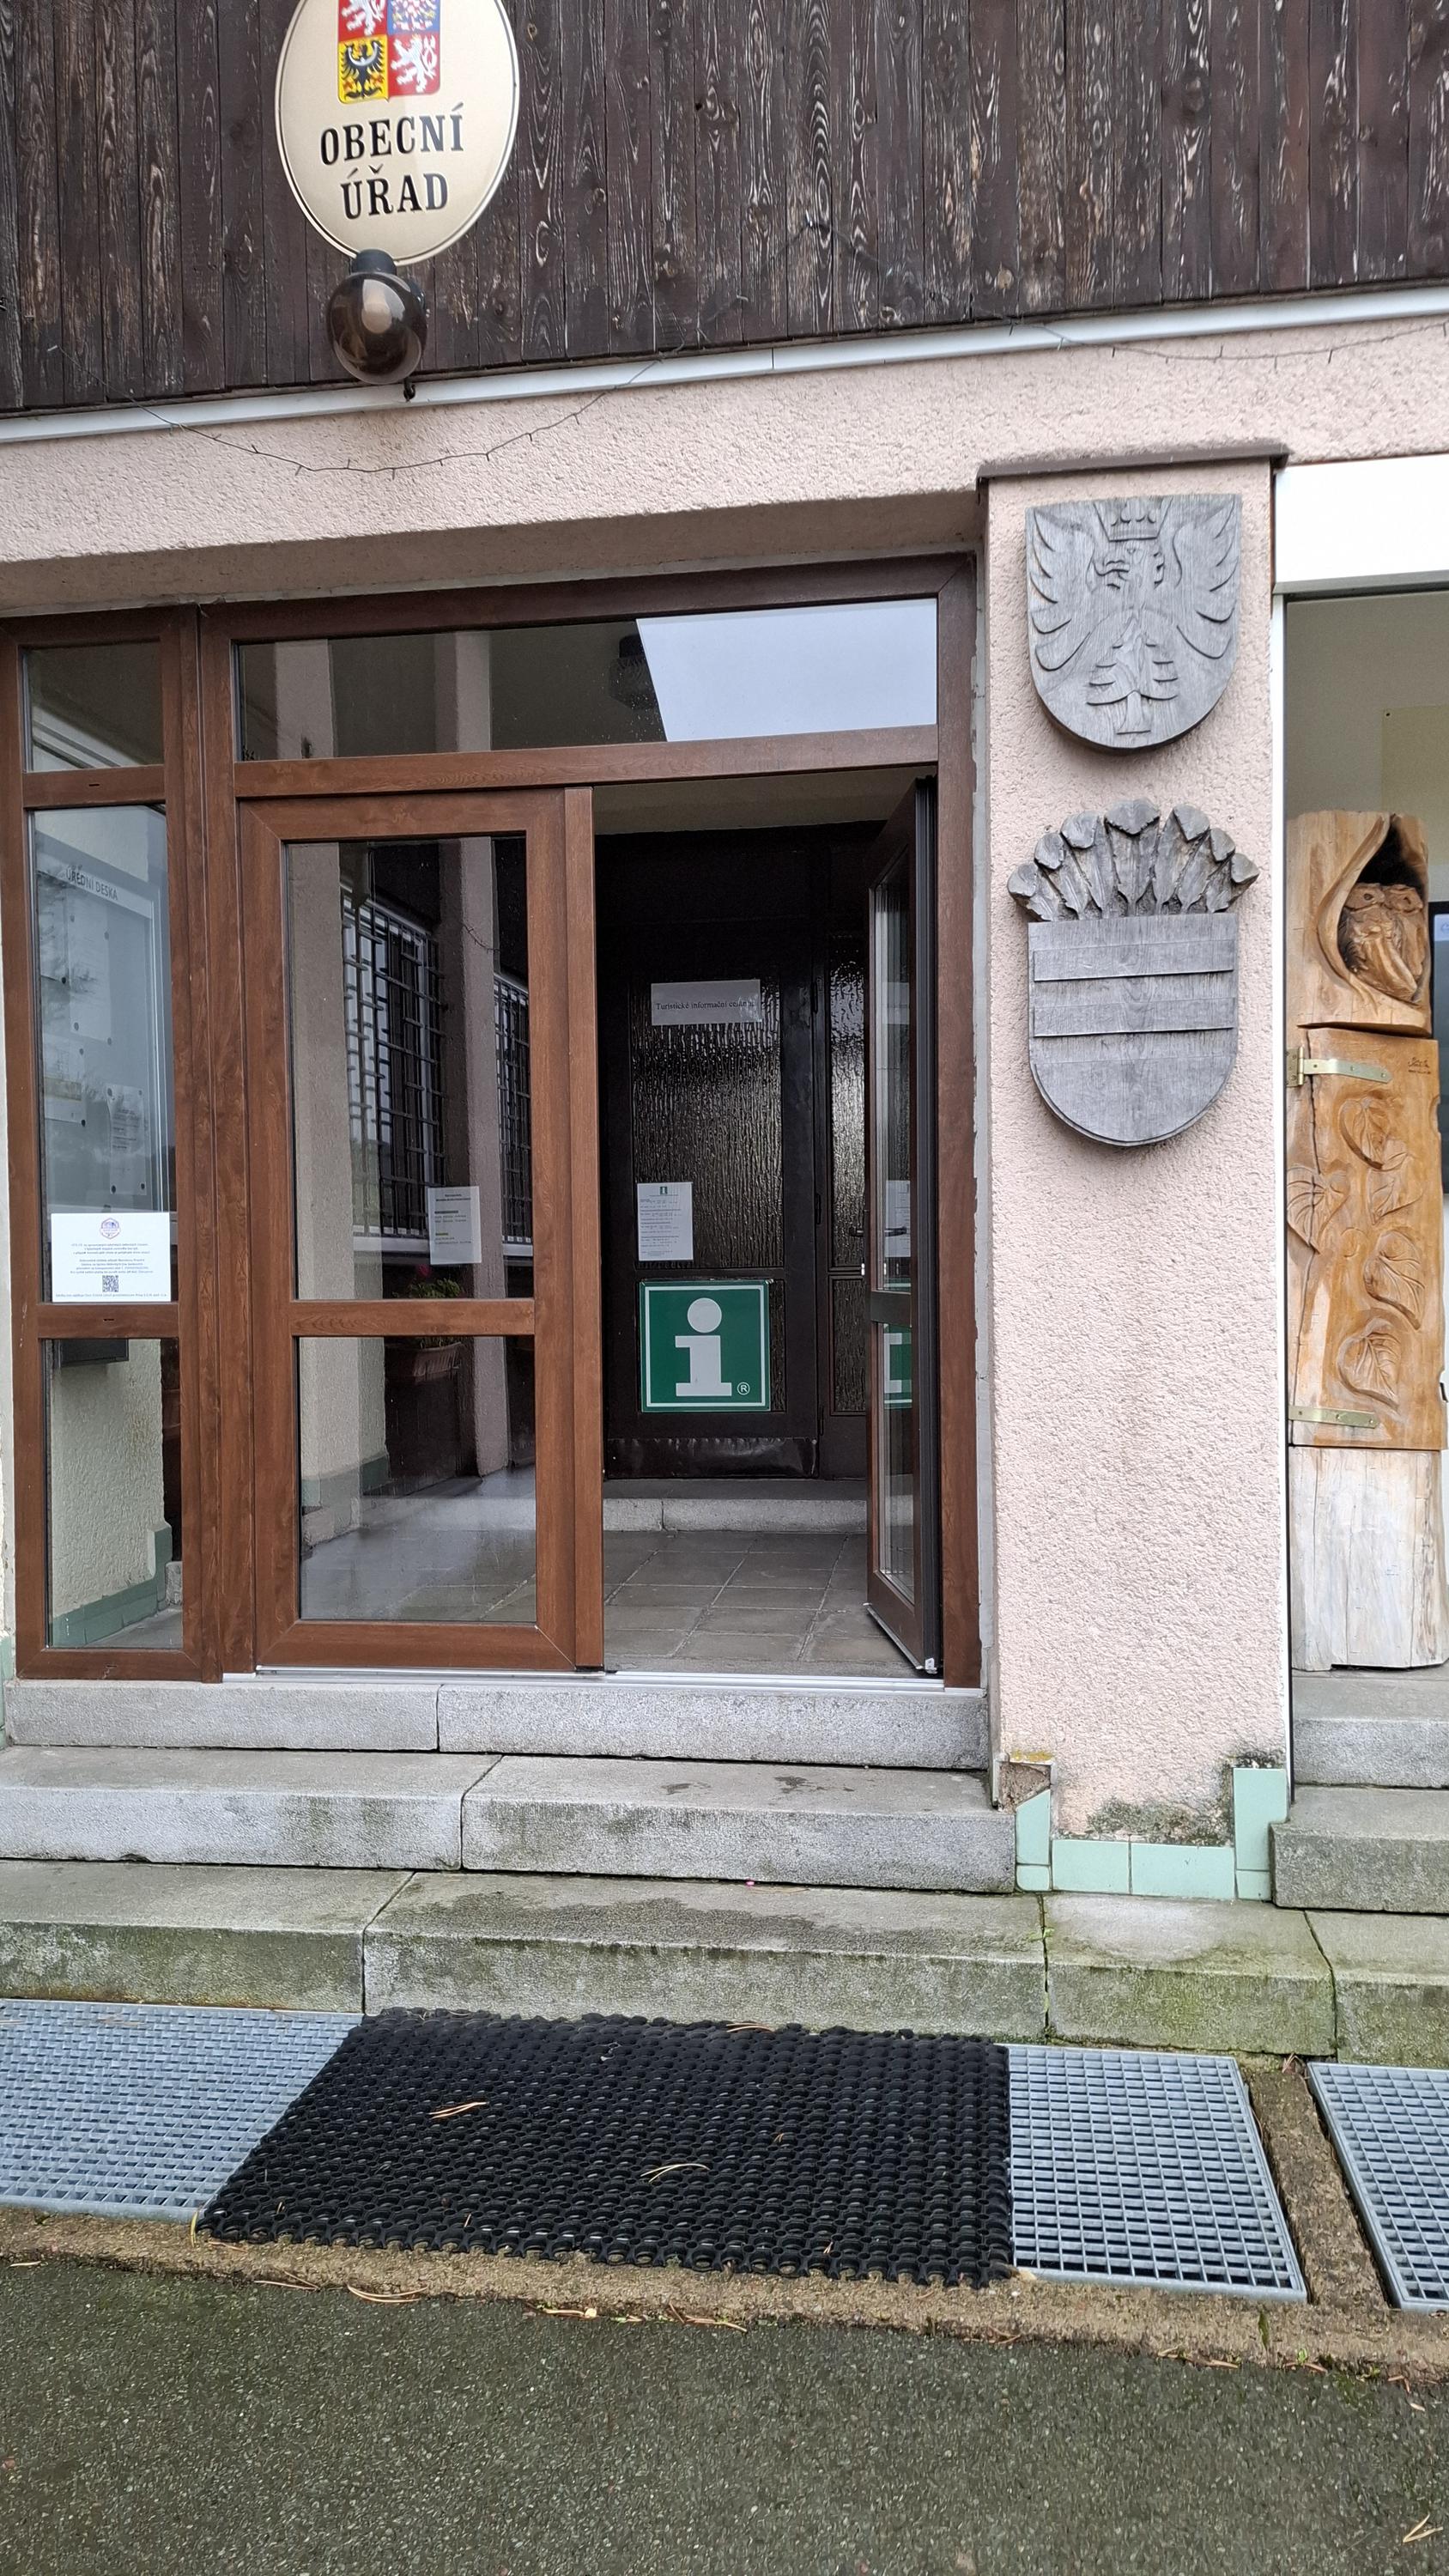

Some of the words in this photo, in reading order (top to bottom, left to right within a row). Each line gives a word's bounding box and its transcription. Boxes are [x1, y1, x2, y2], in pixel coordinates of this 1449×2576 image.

[320, 102, 464, 166] OBECNÍ
[341, 163, 448, 220] ÚŘAD
[95, 881, 118, 901] DESKA
[656, 1002, 689, 1011] Turistické
